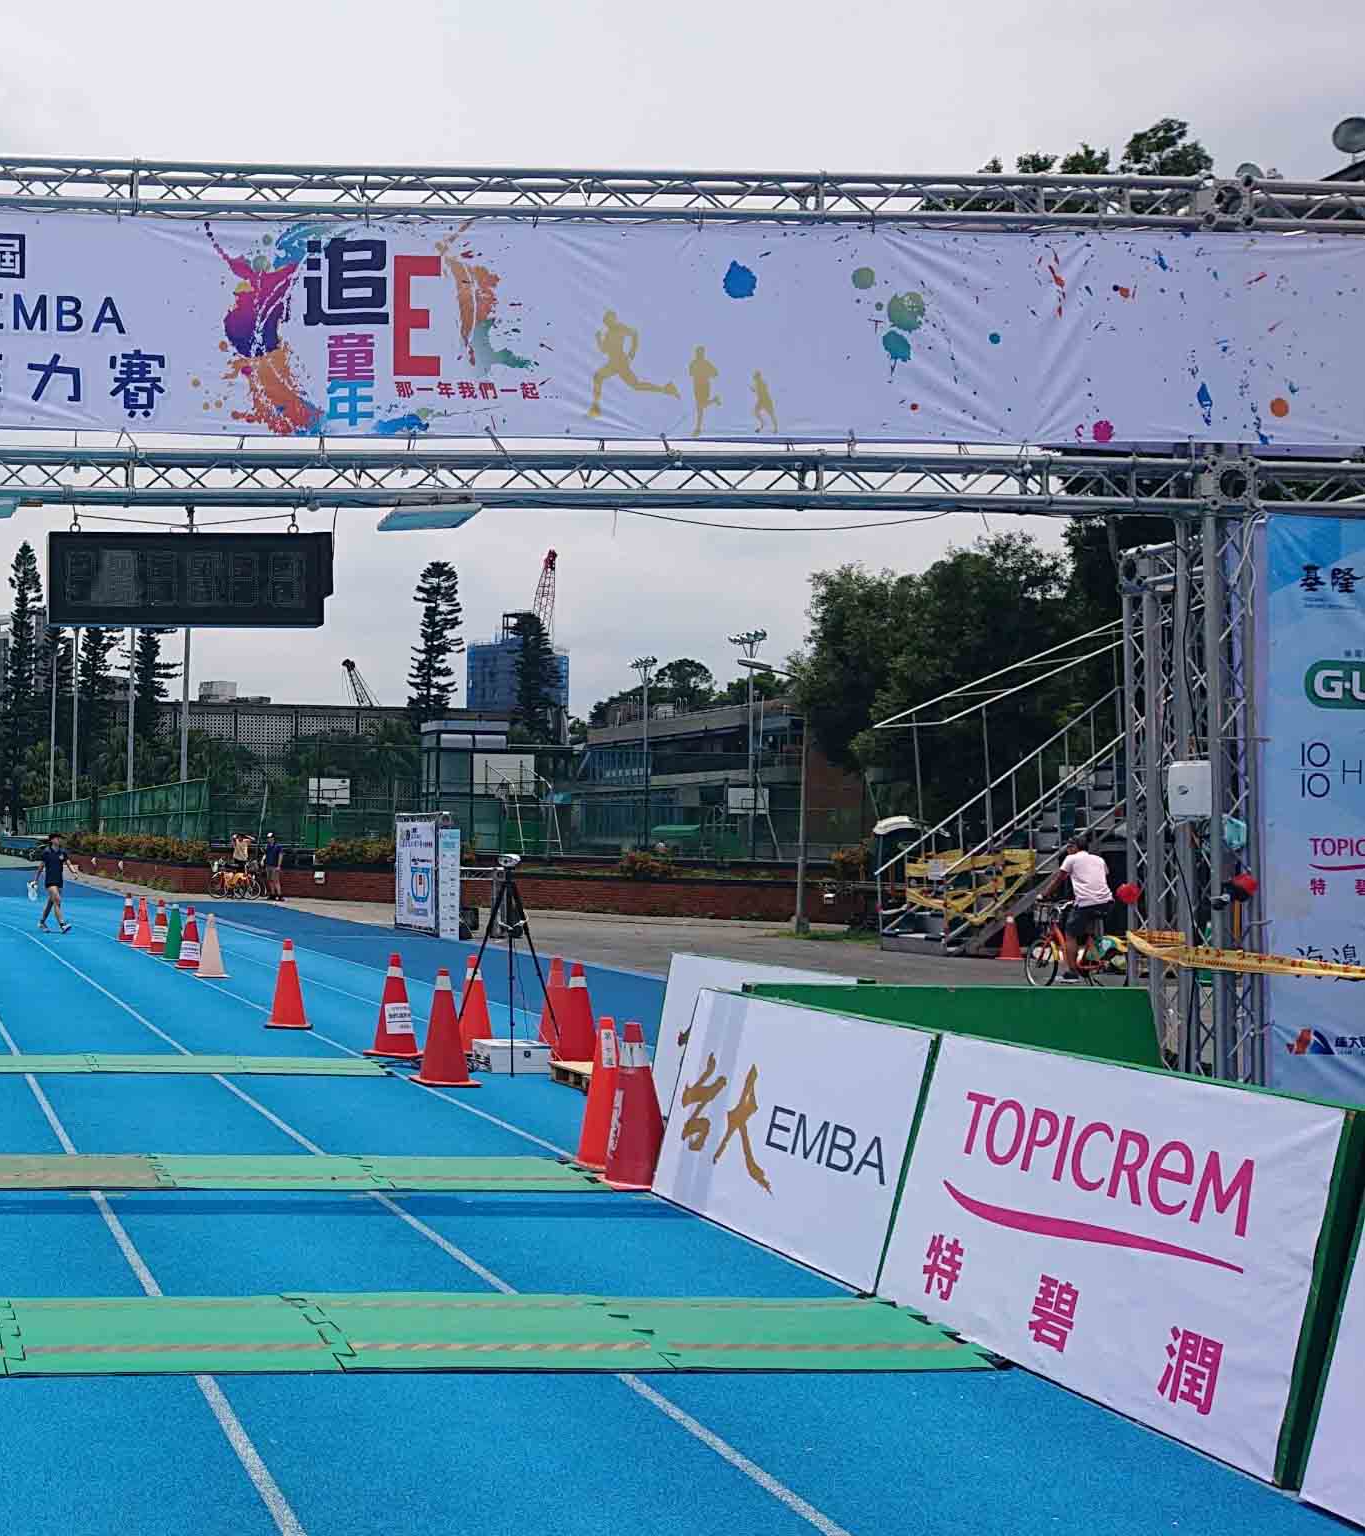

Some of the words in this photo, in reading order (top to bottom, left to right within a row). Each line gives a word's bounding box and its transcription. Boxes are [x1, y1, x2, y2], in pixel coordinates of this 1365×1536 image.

[327, 332, 375, 427] 童年
[922, 1233, 1225, 1417] 特碧潤
